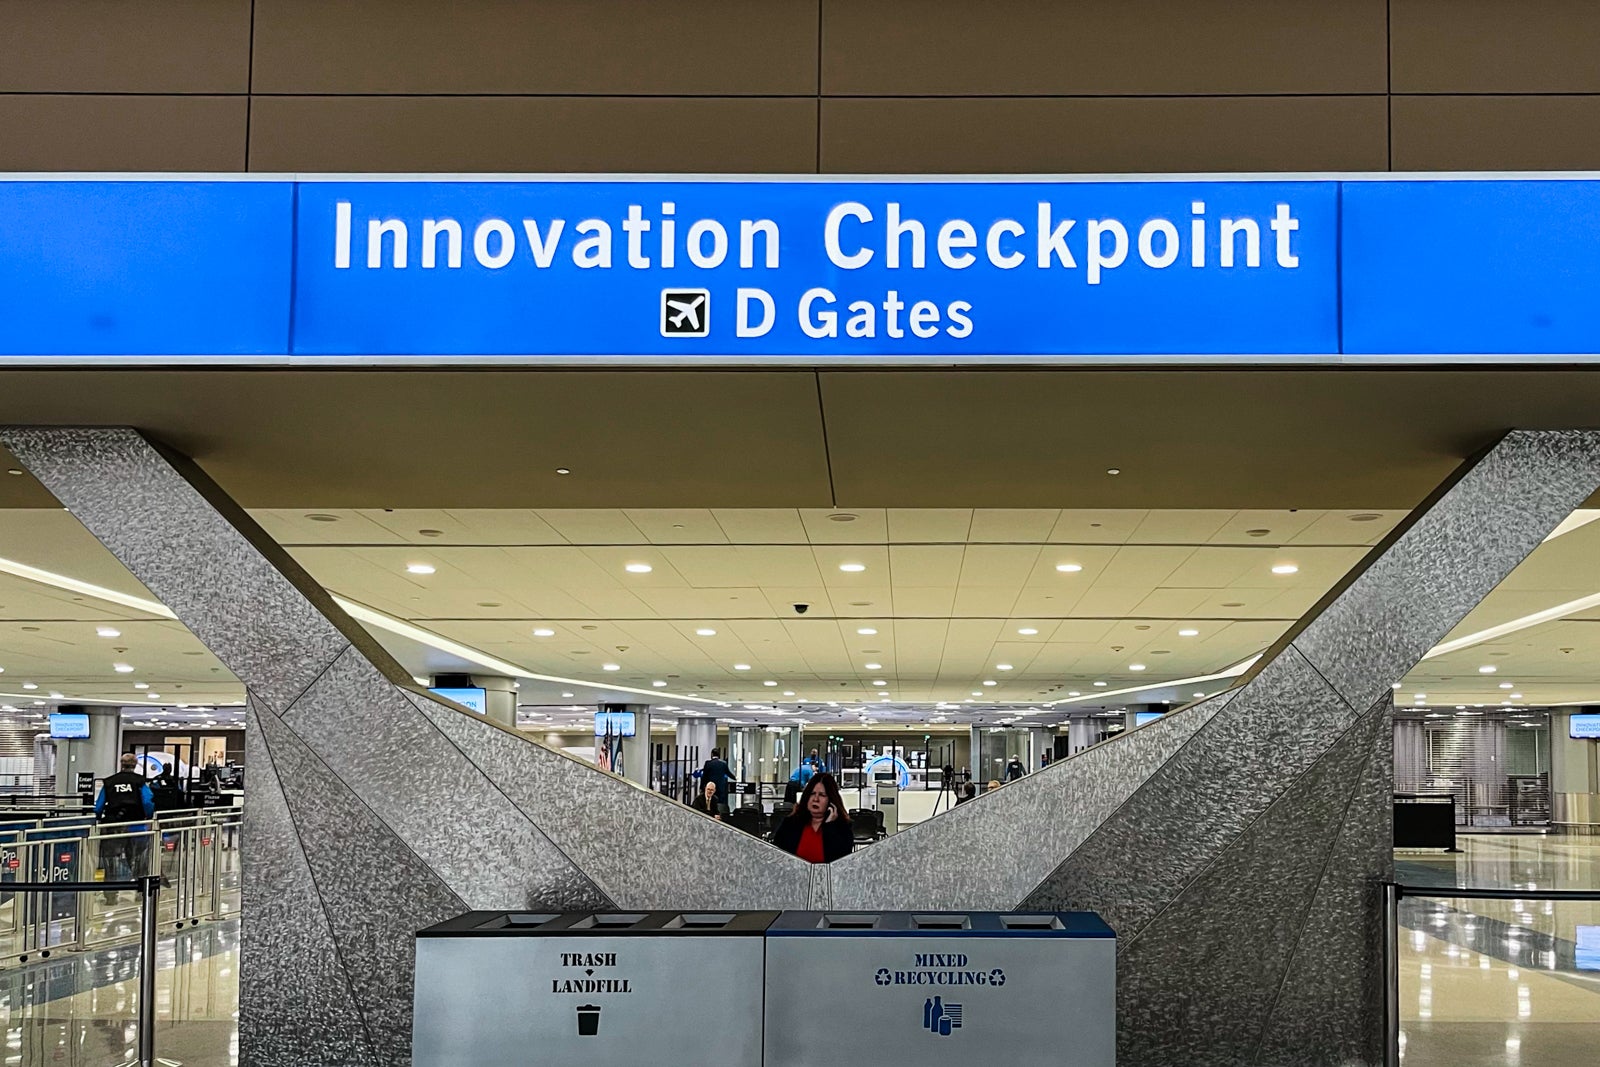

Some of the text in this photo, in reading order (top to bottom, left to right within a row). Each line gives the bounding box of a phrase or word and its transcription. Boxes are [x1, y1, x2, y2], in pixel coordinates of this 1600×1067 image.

[335, 201, 1299, 285] Innovation Checkpoint
[736, 287, 974, 340] D Gates
[114, 783, 132, 793] TSA
[2, 850, 16, 864] Pre
[53, 866, 69, 882] Pre
[560, 953, 617, 967] TRASH
[914, 953, 968, 968] MIXED
[894, 970, 987, 986] RECYCLING
[552, 979, 632, 993] LANDFILL
